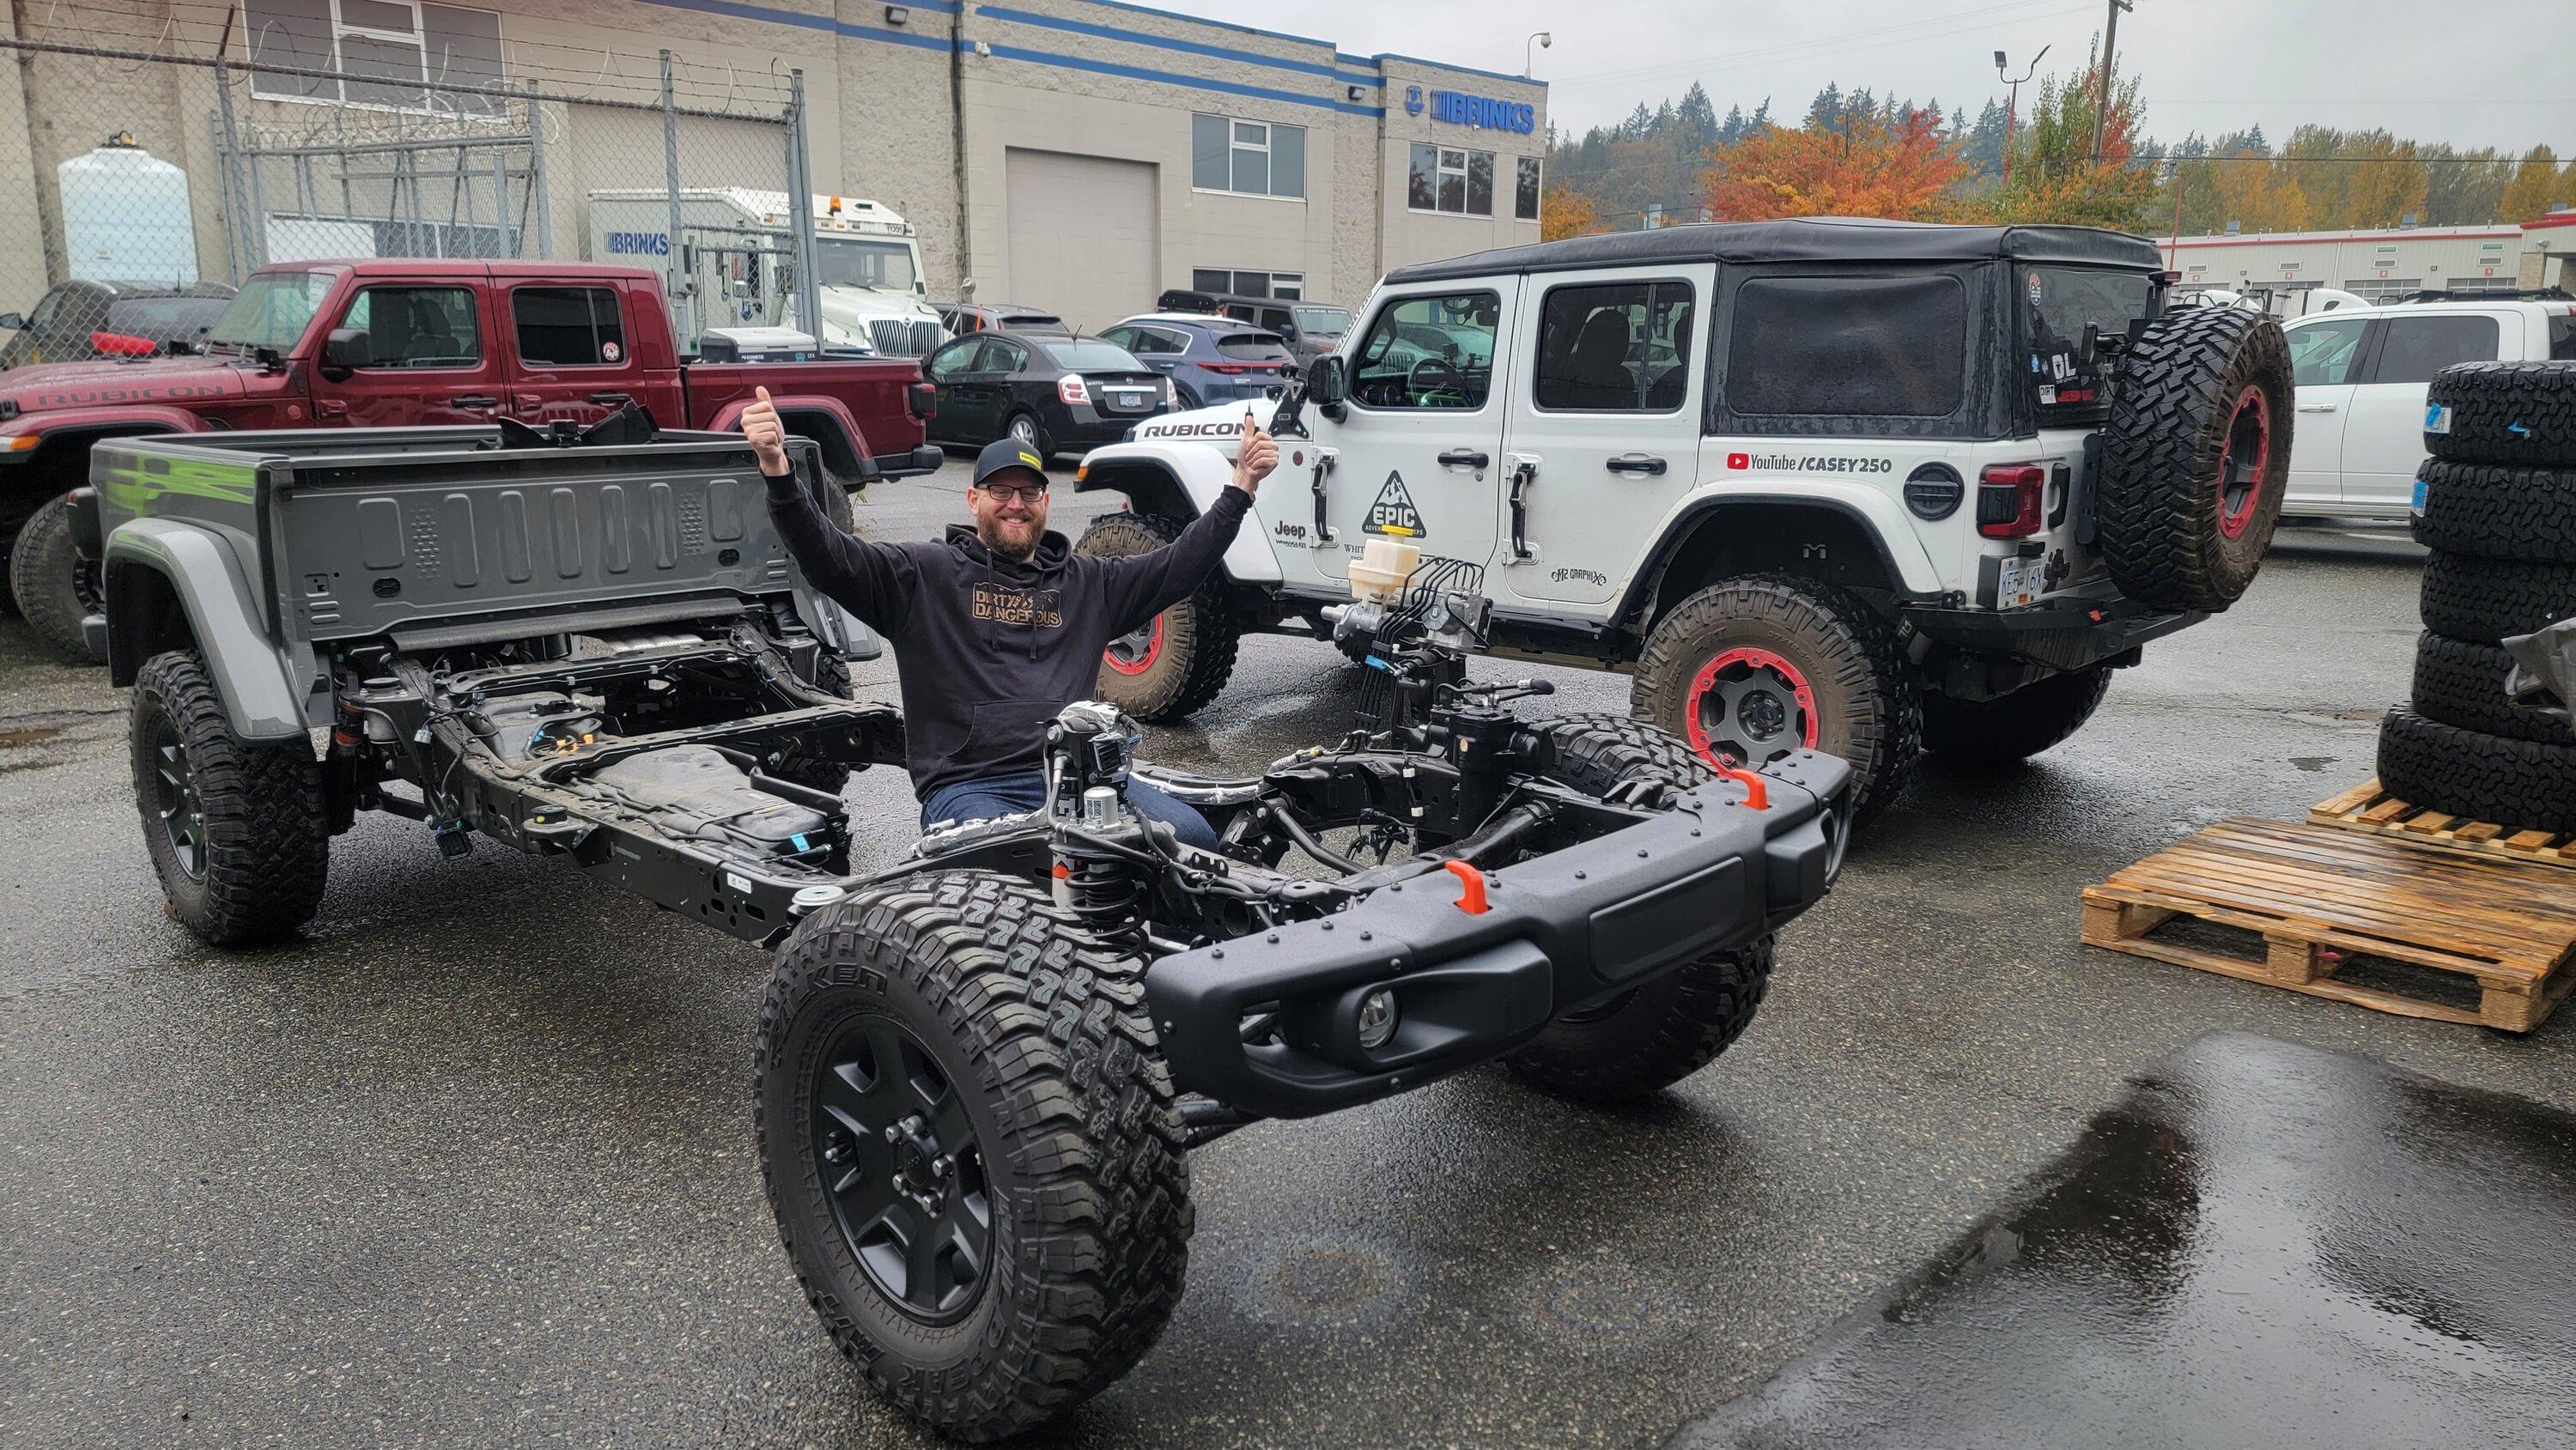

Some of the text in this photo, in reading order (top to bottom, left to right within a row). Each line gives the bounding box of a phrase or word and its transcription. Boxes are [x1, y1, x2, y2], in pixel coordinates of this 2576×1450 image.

[1450, 92, 1535, 135] BRINKS
[613, 232, 670, 256] BRINKS
[38, 385, 225, 406] RUBICON
[1751, 454, 1893, 473] YouTube /CASEY250
[1373, 506, 1415, 527] EPIC
[1274, 520, 1306, 540] Jeep
[975, 590, 1016, 608] DIRTY
